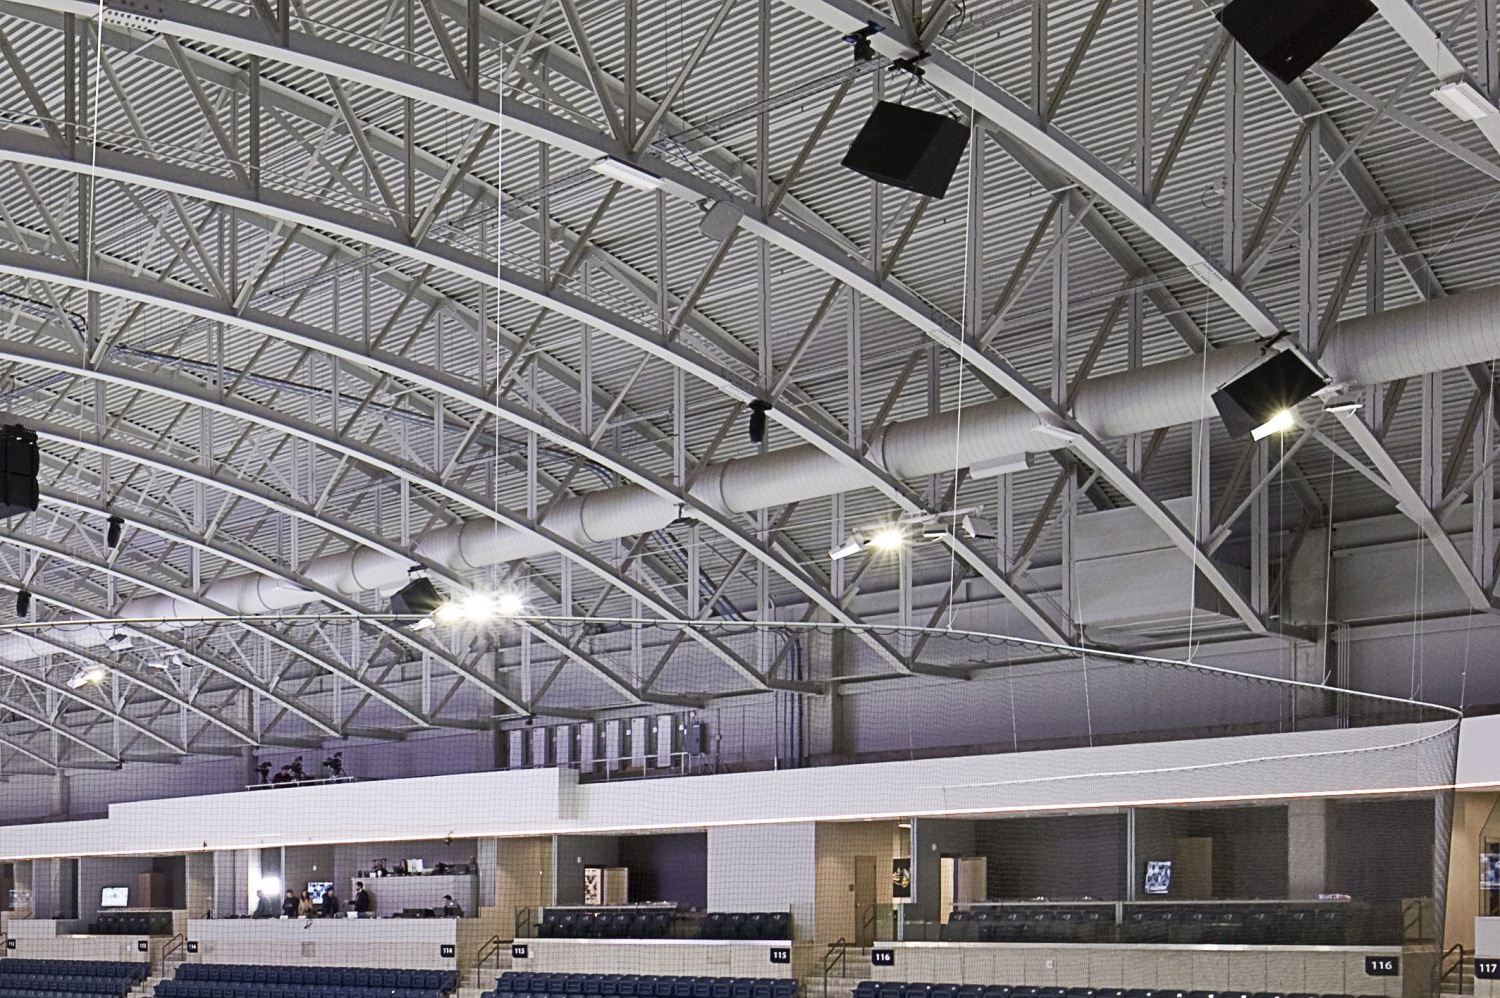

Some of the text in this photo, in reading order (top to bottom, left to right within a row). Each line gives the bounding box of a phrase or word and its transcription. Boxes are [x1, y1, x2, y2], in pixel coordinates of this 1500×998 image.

[773, 951, 787, 959] 115
[876, 953, 891, 961] 116
[1371, 961, 1393, 970] 116
[1479, 963, 1498, 973] 117
